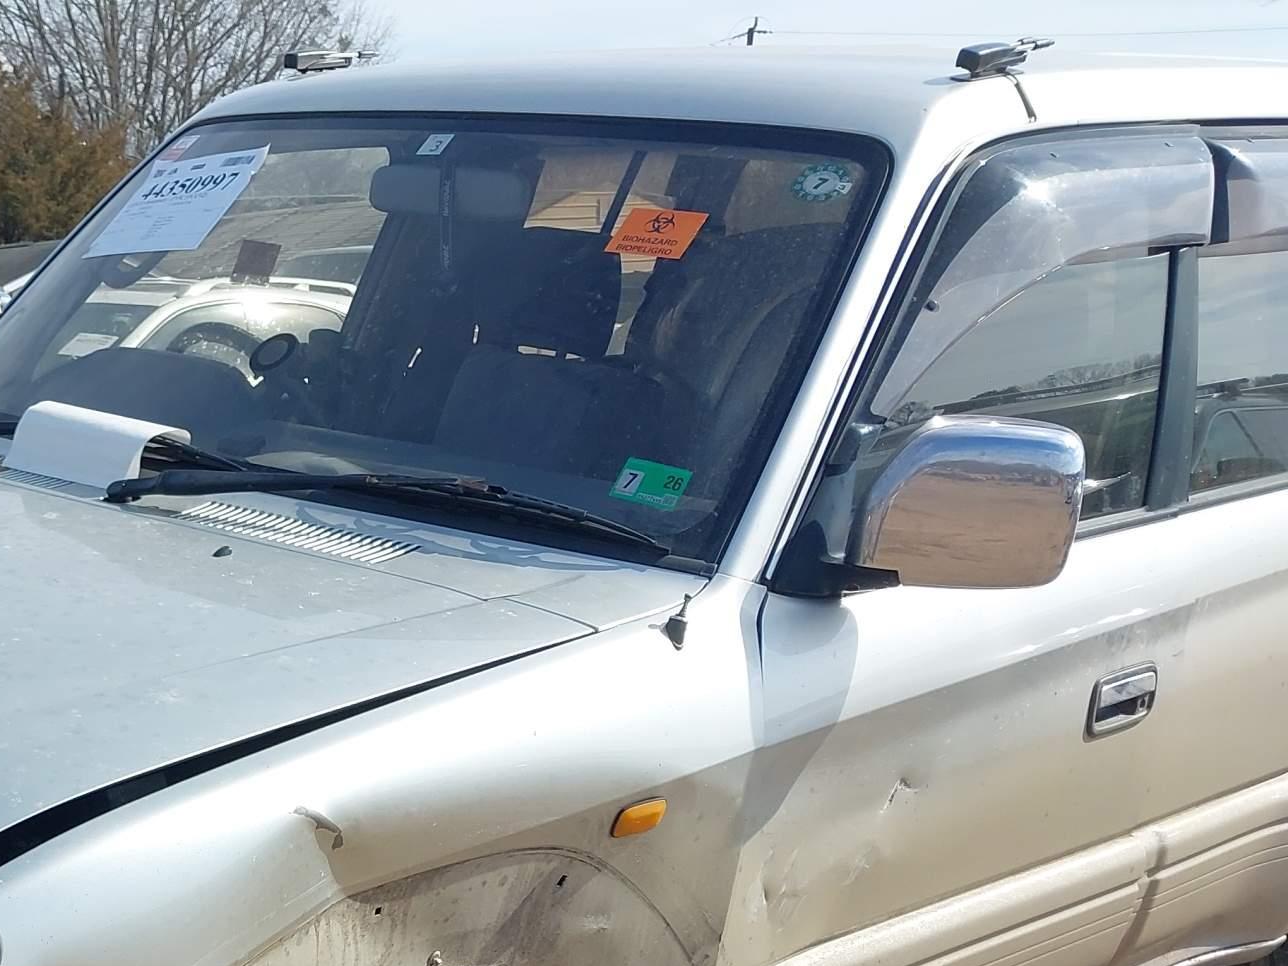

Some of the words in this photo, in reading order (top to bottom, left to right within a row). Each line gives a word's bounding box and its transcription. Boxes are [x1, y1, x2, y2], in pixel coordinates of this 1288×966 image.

[142, 171, 240, 200] 44350997
[812, 176, 830, 190] 7
[622, 234, 679, 246] BIOHAZARD
[616, 243, 672, 255] BIOPELIGRO
[622, 472, 639, 489] 7
[663, 475, 684, 491] 26
